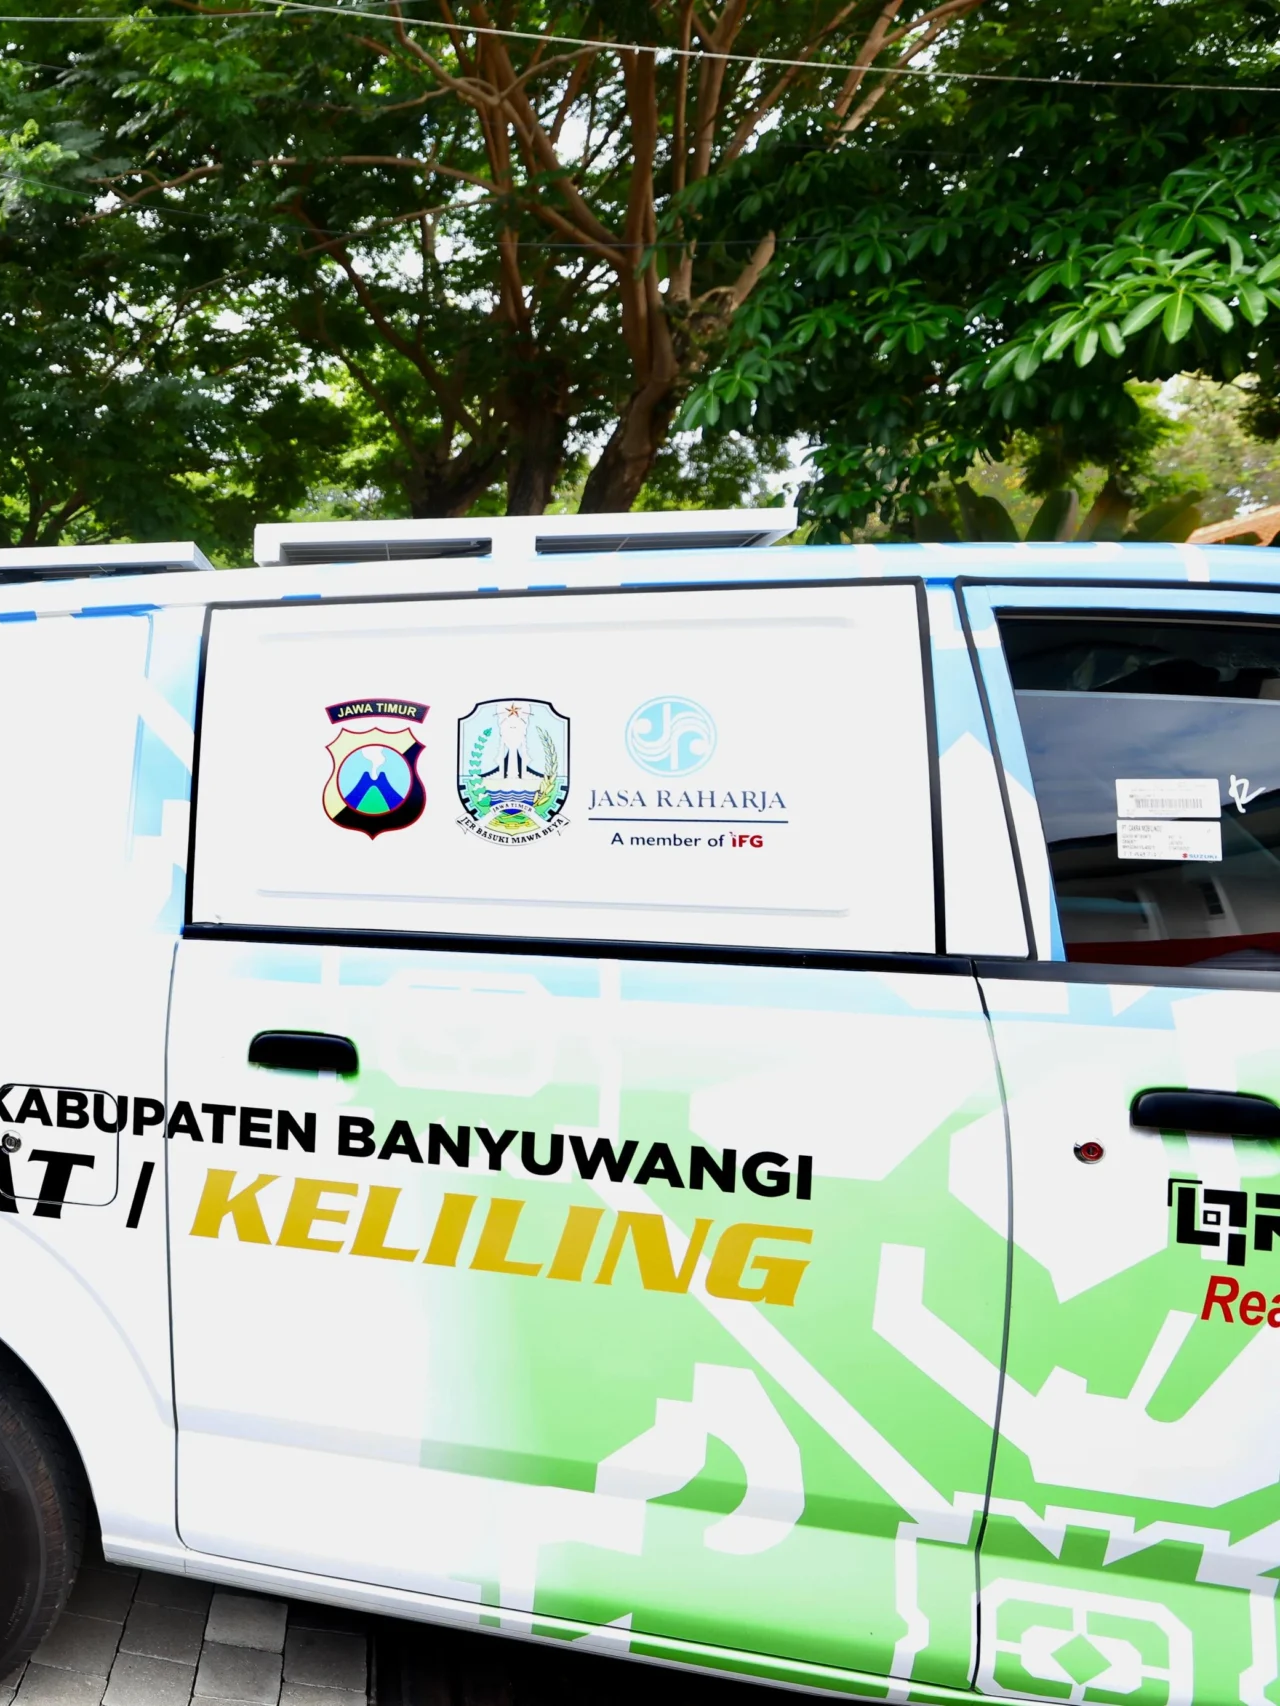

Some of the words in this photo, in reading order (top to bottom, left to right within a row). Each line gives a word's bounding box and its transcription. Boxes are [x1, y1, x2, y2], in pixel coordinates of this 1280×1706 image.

[337, 703, 373, 718] JAWA
[376, 702, 417, 717] TIMUR
[492, 803, 509, 813] JAWA
[588, 789, 647, 810] JASA
[656, 789, 787, 812] RAHARJA
[460, 816, 475, 830] JER
[476, 827, 509, 844] BASUKI
[511, 832, 541, 844] MAWA
[543, 818, 564, 836] BEYA
[610, 832, 624, 845] A
[630, 834, 701, 847] member
[707, 834, 725, 847] of
[337, 1115, 813, 1200] BANYUWANGI
[189, 1167, 813, 1307] KELILING
